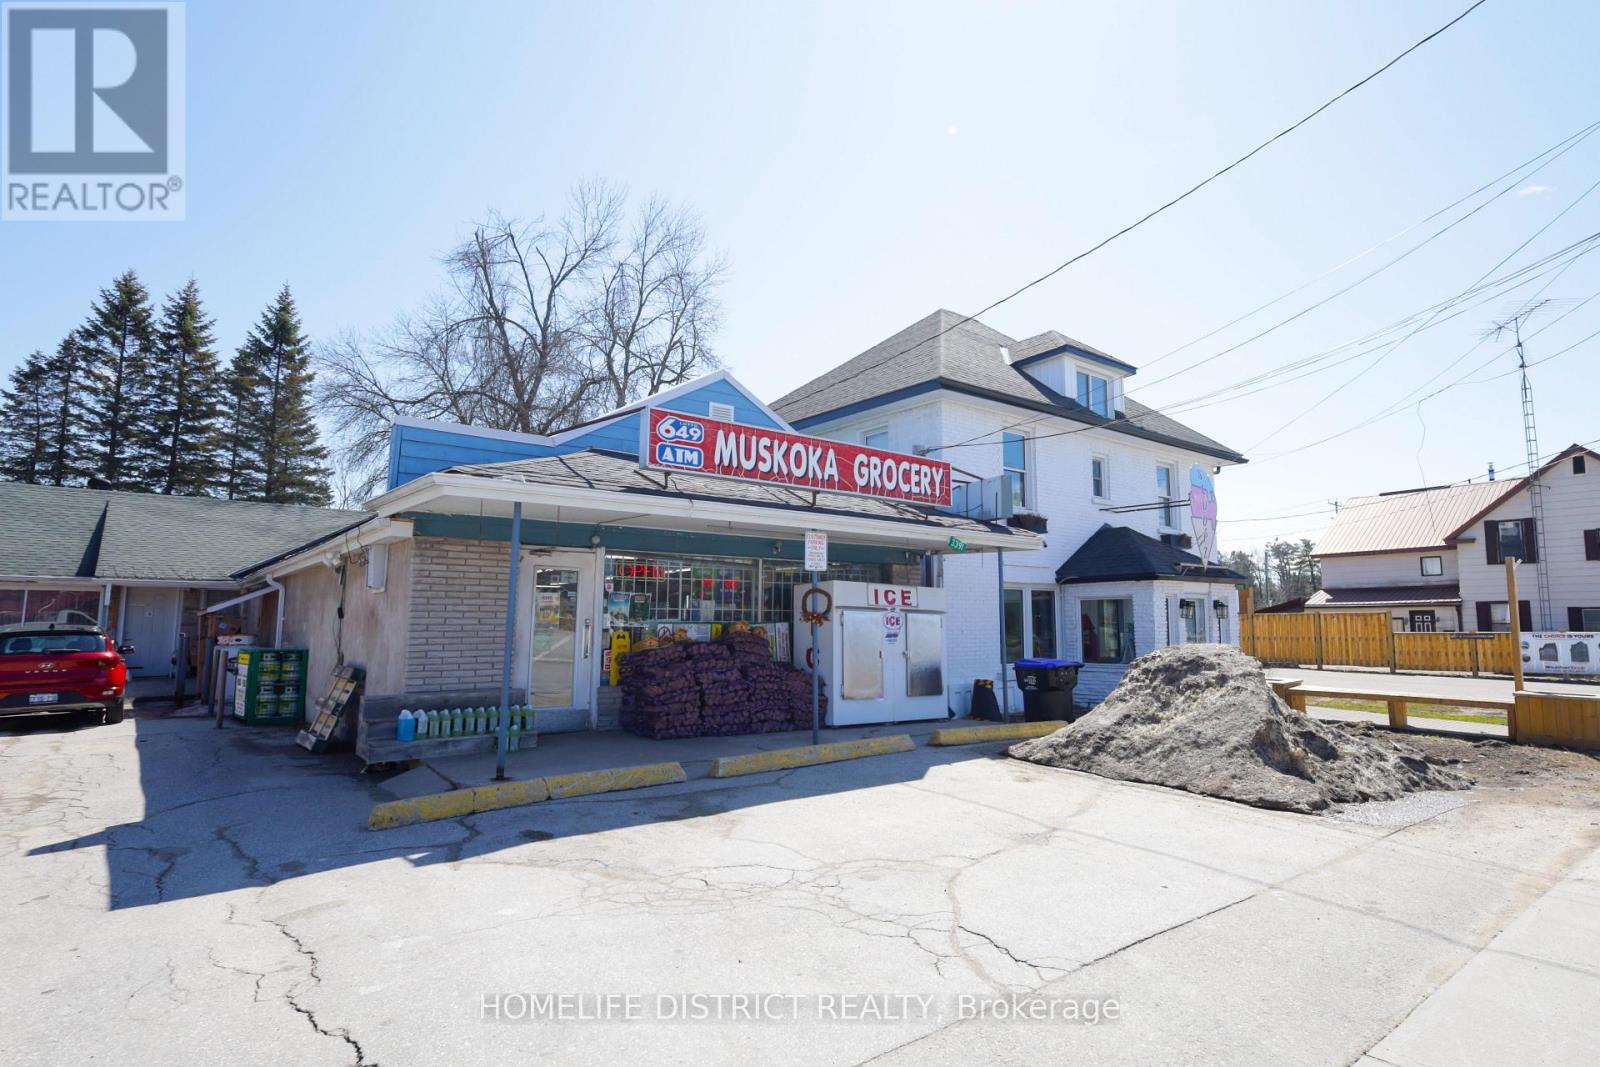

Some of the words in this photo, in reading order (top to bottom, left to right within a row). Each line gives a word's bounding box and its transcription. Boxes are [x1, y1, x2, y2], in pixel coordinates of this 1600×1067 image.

[659, 418, 702, 441] 649
[661, 446, 699, 465] ATM
[714, 429, 839, 482] MUSKOKA
[853, 453, 944, 498] GROCERY
[618, 563, 665, 578] OPEN
[873, 588, 913, 606] ICE
[885, 615, 901, 626] ICE
